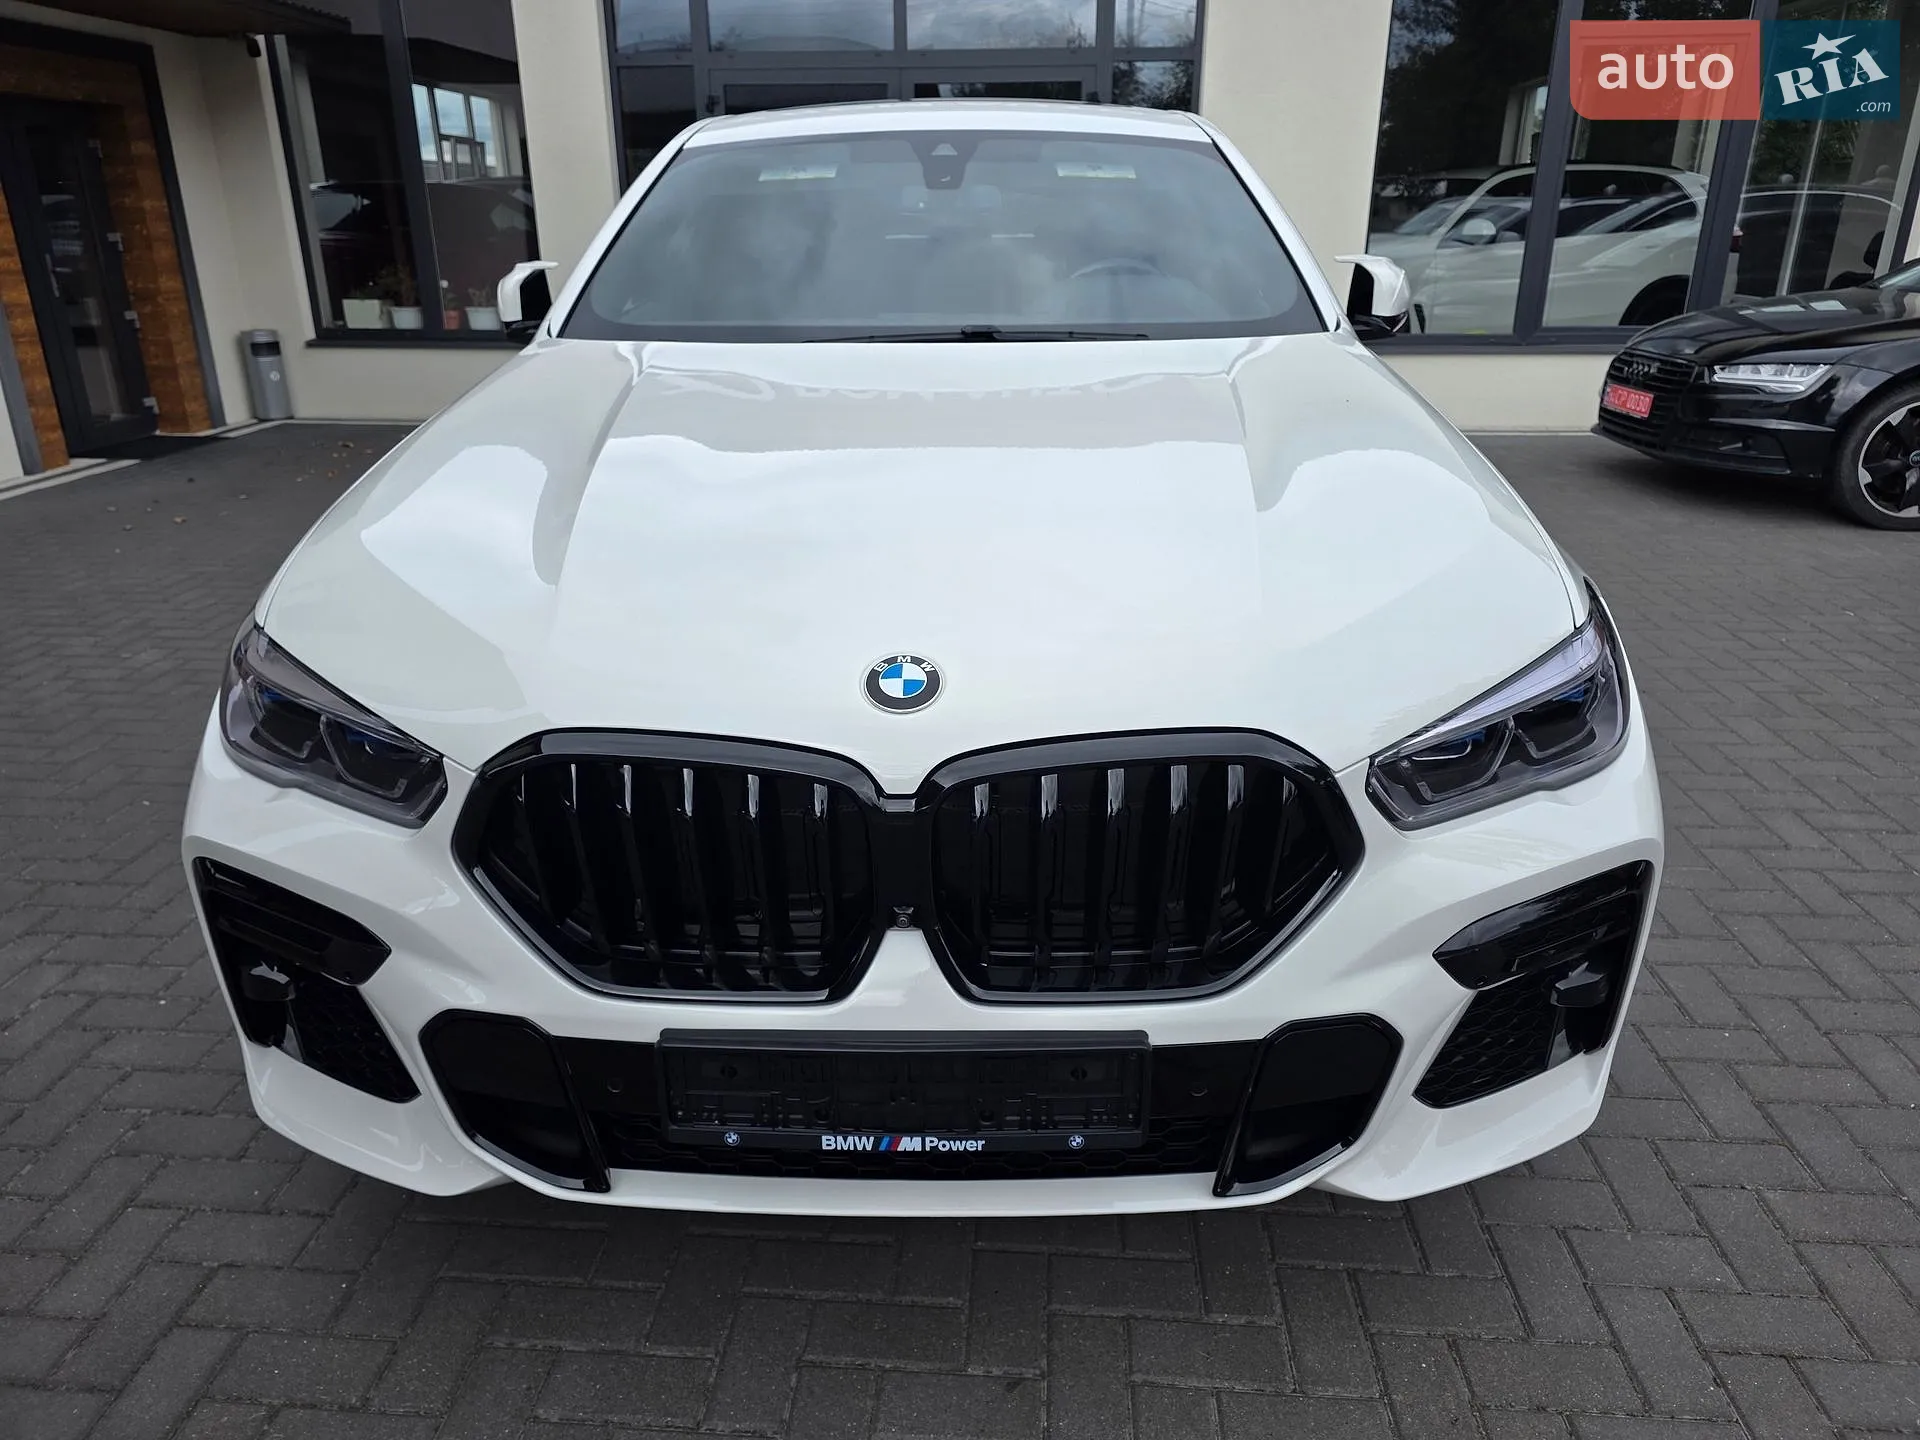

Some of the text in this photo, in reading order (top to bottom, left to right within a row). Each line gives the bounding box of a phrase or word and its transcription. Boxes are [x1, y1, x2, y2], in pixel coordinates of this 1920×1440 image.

[873, 655, 936, 673] BMW
[821, 1135, 875, 1151] BMW
[925, 1136, 986, 1152] Power
